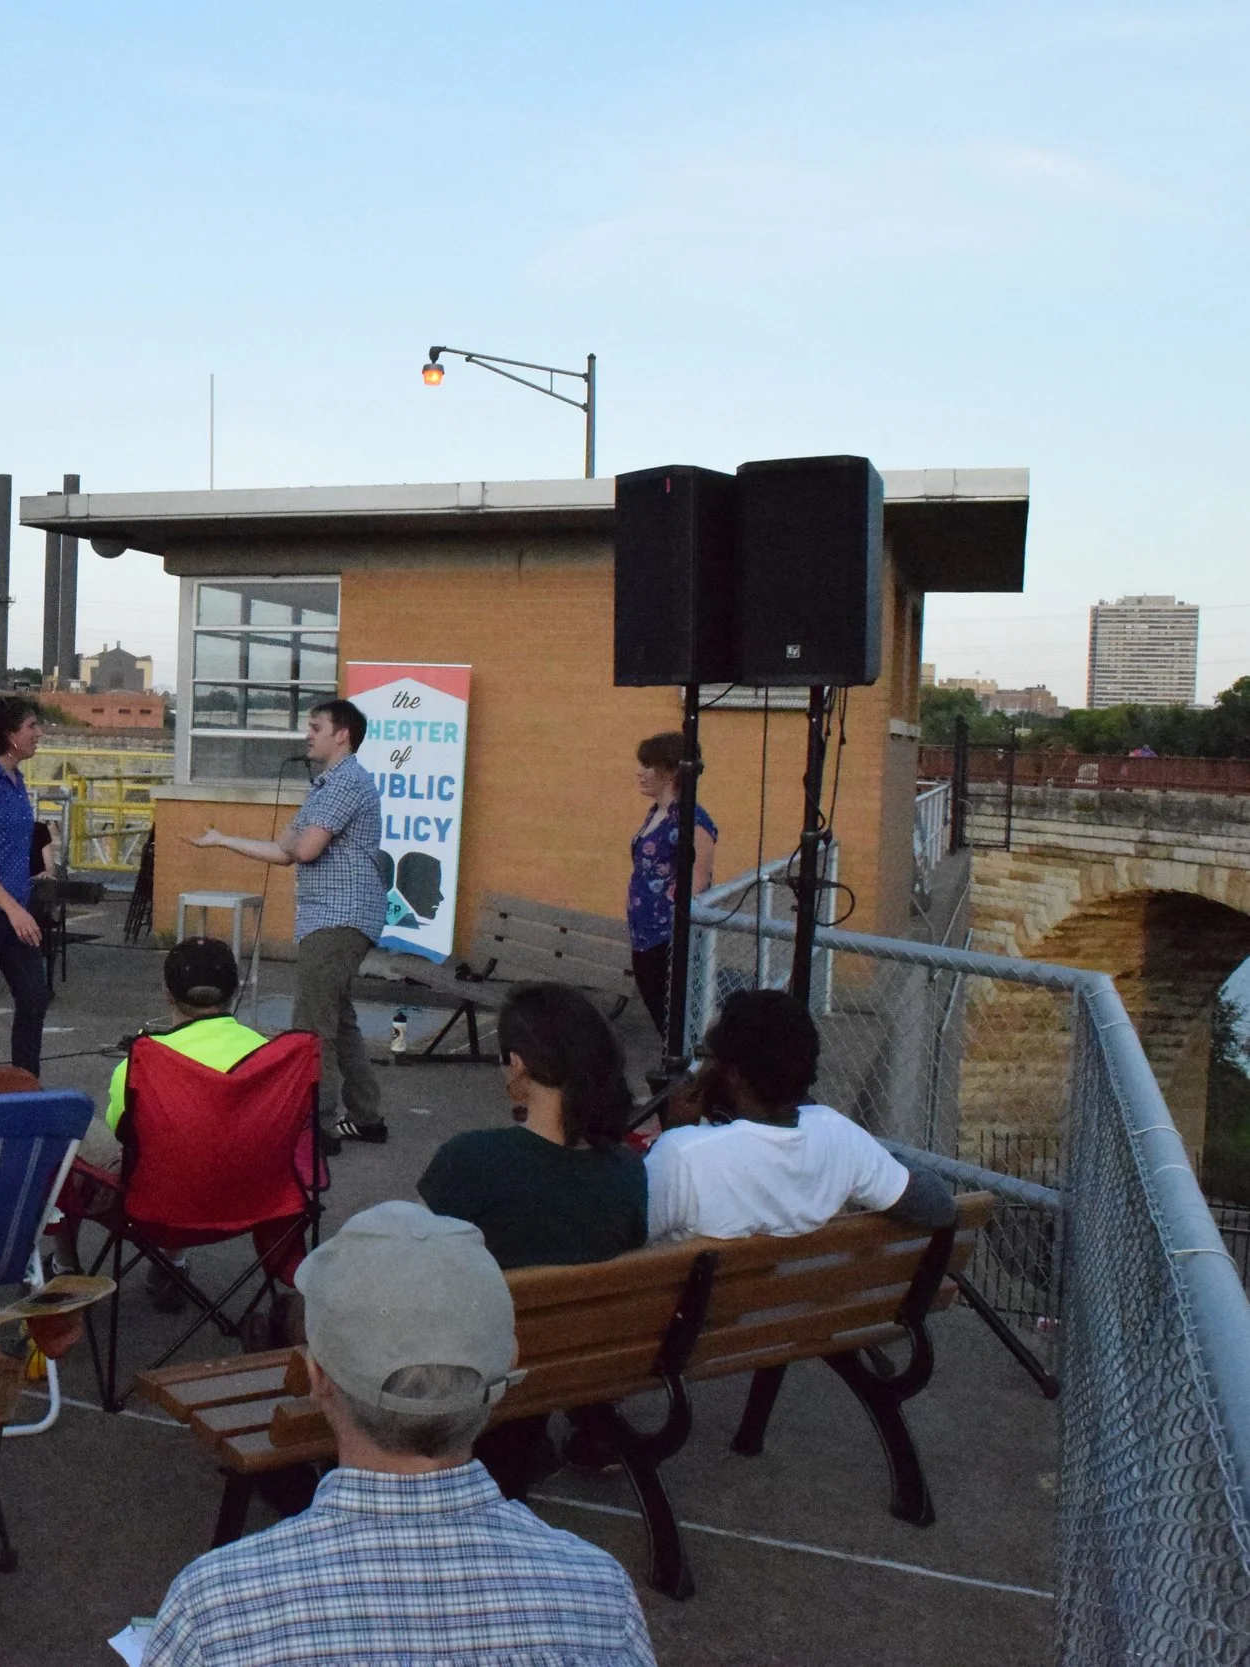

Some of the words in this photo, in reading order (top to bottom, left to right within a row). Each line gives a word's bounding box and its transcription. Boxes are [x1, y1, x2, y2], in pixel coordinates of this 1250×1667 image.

[392, 691, 420, 709] the
[367, 719, 458, 743] HEATER
[390, 745, 412, 769] of
[369, 772, 455, 801] UBLIC
[385, 814, 453, 843] LICY
